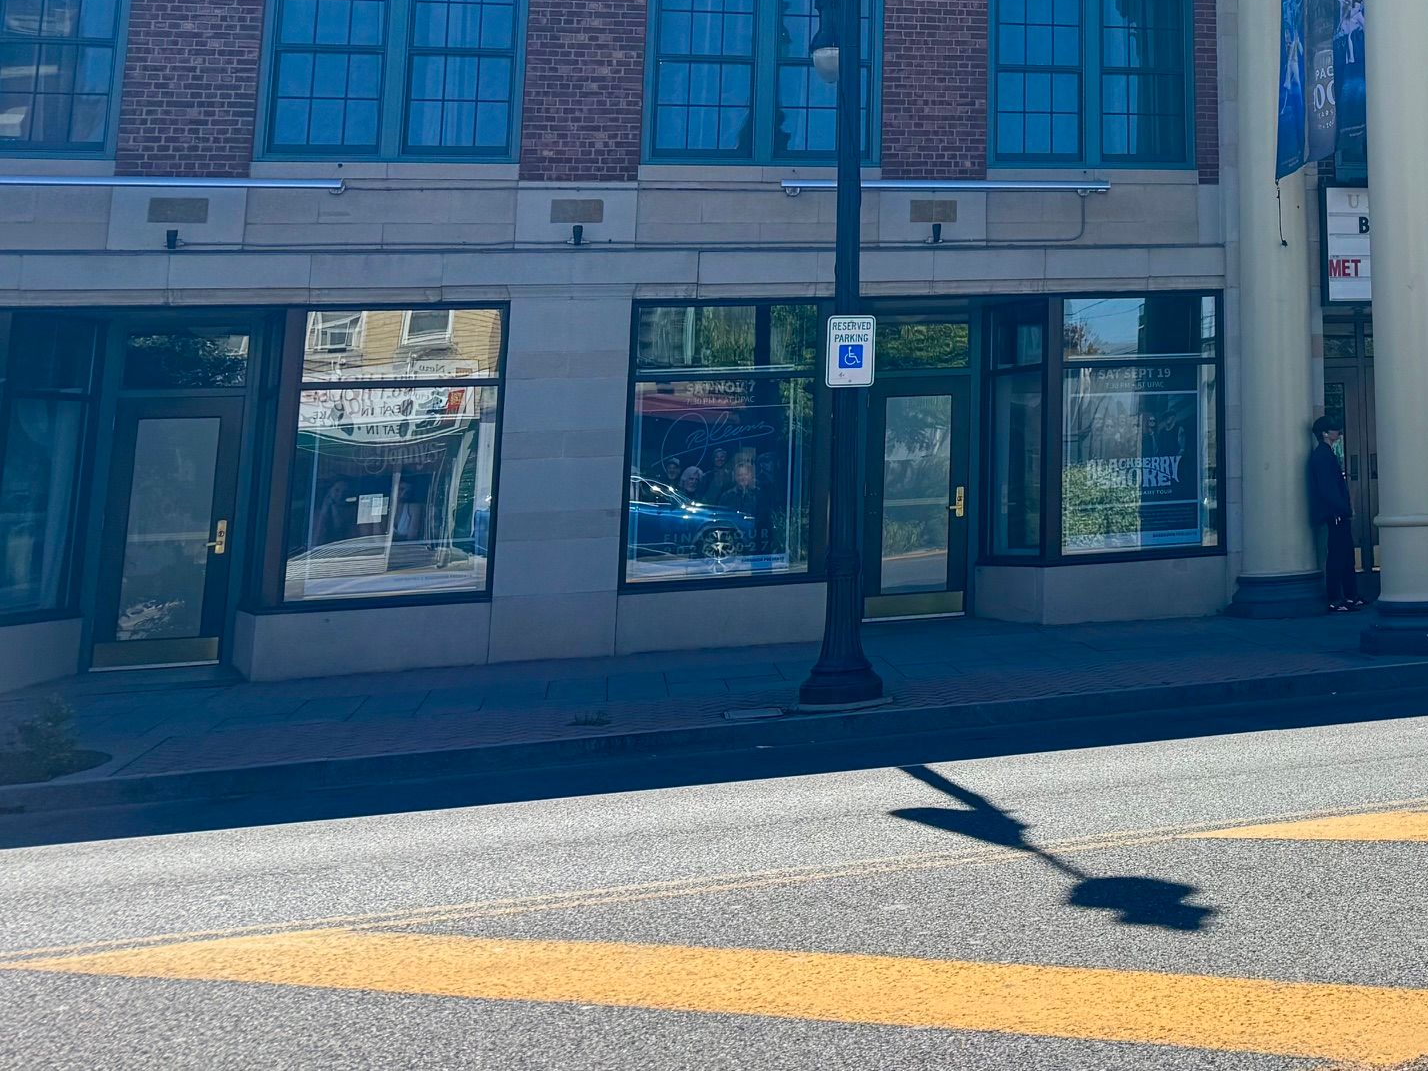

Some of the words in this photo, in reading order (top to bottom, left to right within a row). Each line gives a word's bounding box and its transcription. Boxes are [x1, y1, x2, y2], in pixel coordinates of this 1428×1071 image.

[1328, 258, 1361, 277] MET
[832, 321, 871, 331] RESERVED
[834, 334, 869, 343] PARKING
[1098, 368, 1121, 380] SAT
[1124, 368, 1154, 379] SEPT
[1157, 368, 1171, 378] 19
[1087, 456, 1183, 482] BLACKBERRY
